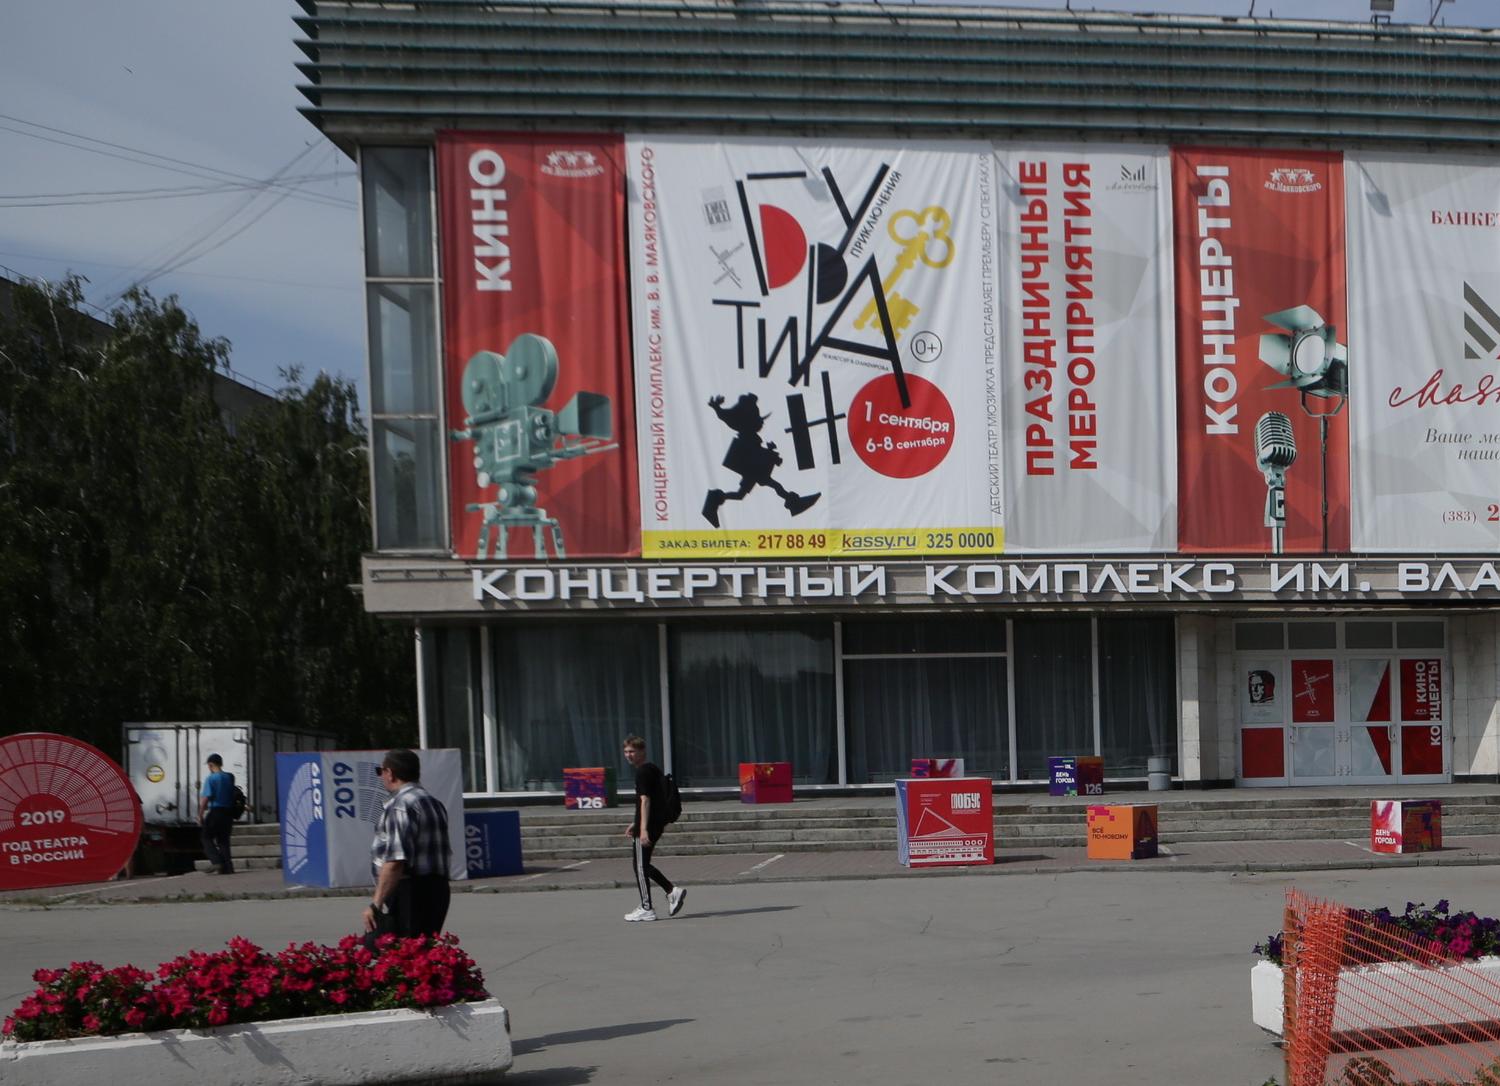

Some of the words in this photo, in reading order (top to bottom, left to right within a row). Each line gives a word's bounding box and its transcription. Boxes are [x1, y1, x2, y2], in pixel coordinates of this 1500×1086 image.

[640, 147, 658, 266] МАЯКОВСКОГО
[978, 153, 991, 219] СПЕКТАКЛЯ
[468, 149, 512, 291] КИНО
[851, 170, 902, 258] ПРИКЛЮЧЕНИЯ
[980, 222, 993, 279] ПРЕМЬЕРУ
[982, 281, 995, 364] ПРЕДСТАВЛЯЕТ
[1019, 161, 1056, 476] ПРАЗДНИЧНЫЕ
[1063, 162, 1098, 470] МЕРОПРИЯТИЯ
[1197, 165, 1240, 434] КОНЦЕРТЫ
[648, 333, 664, 419] КОМПЛЕКС
[985, 368, 998, 426] МЮЗИКЛА
[864, 401, 873, 422] 1
[879, 413, 950, 433] сентября
[866, 436, 893, 452] 6-8
[896, 437, 945, 450] сентября
[1425, 428, 1472, 444] Ваше
[987, 429, 999, 460] ТЕАТР
[651, 423, 668, 522] КОНЦЕРТНЫЙ
[988, 463, 1001, 515] ДЕТСКИЙ
[658, 538, 698, 549] ЗАКАЗ
[701, 538, 751, 549] БИЛЕТА:
[757, 534, 782, 549] 217
[786, 534, 806, 548] 88
[808, 534, 826, 548] 49
[842, 533, 917, 550] kassy.ru
[926, 533, 954, 548] 325
[958, 532, 995, 548] 0000
[1442, 511, 1477, 524] (383)
[471, 564, 886, 603] КОНЦЕРТНЫЙ
[925, 560, 1238, 596] КОМПЛЕКС
[1269, 563, 1370, 594] ИМ.
[1415, 661, 1428, 703] КИНО
[1428, 660, 1441, 746] КОНЦЕРТЫ
[312, 761, 323, 820] 2019
[332, 762, 356, 819] 2019
[576, 797, 603, 809] 126
[1085, 783, 1102, 794] 126
[2, 840, 31, 853] ГОД
[35, 836, 88, 849] ТЕАТРА
[20, 809, 65, 826] 2019
[10, 854, 20, 864] В
[23, 849, 84, 863] РОССИИ
[466, 824, 484, 871] 2019
